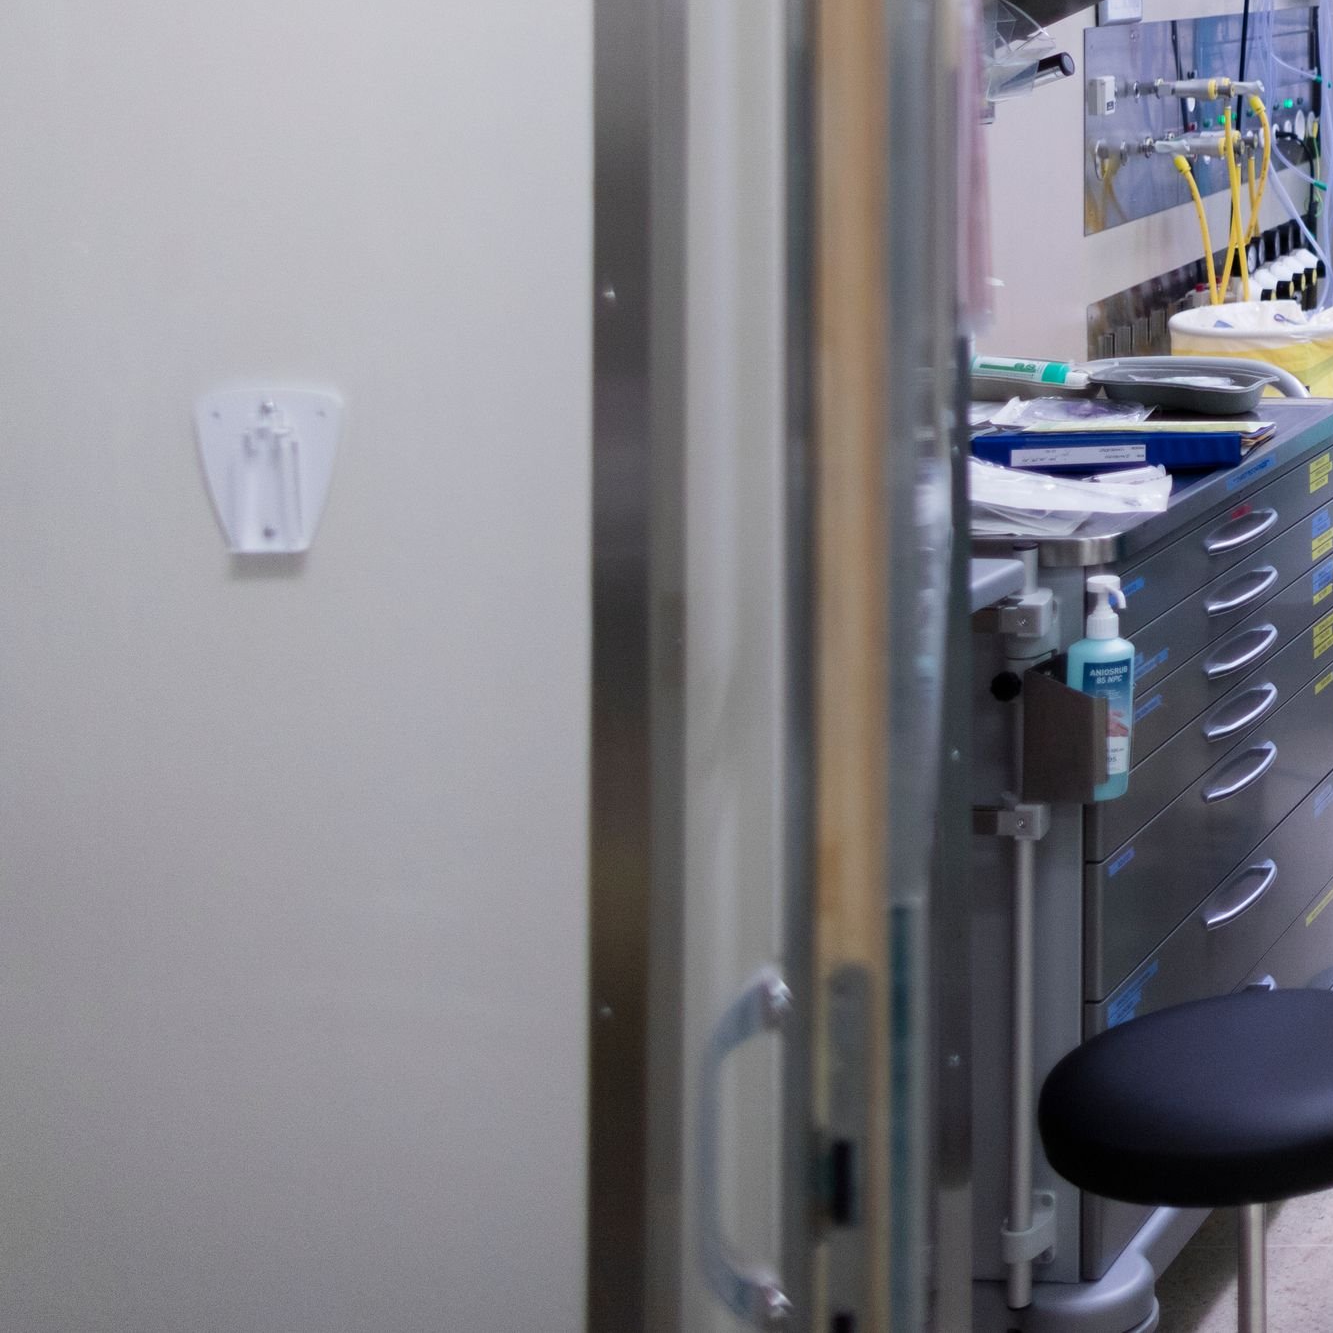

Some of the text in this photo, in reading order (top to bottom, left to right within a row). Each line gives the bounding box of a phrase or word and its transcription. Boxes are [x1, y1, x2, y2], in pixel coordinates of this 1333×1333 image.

[1089, 665, 1128, 677] ANIOSRUB
[1096, 674, 1123, 684] 85 NPC
